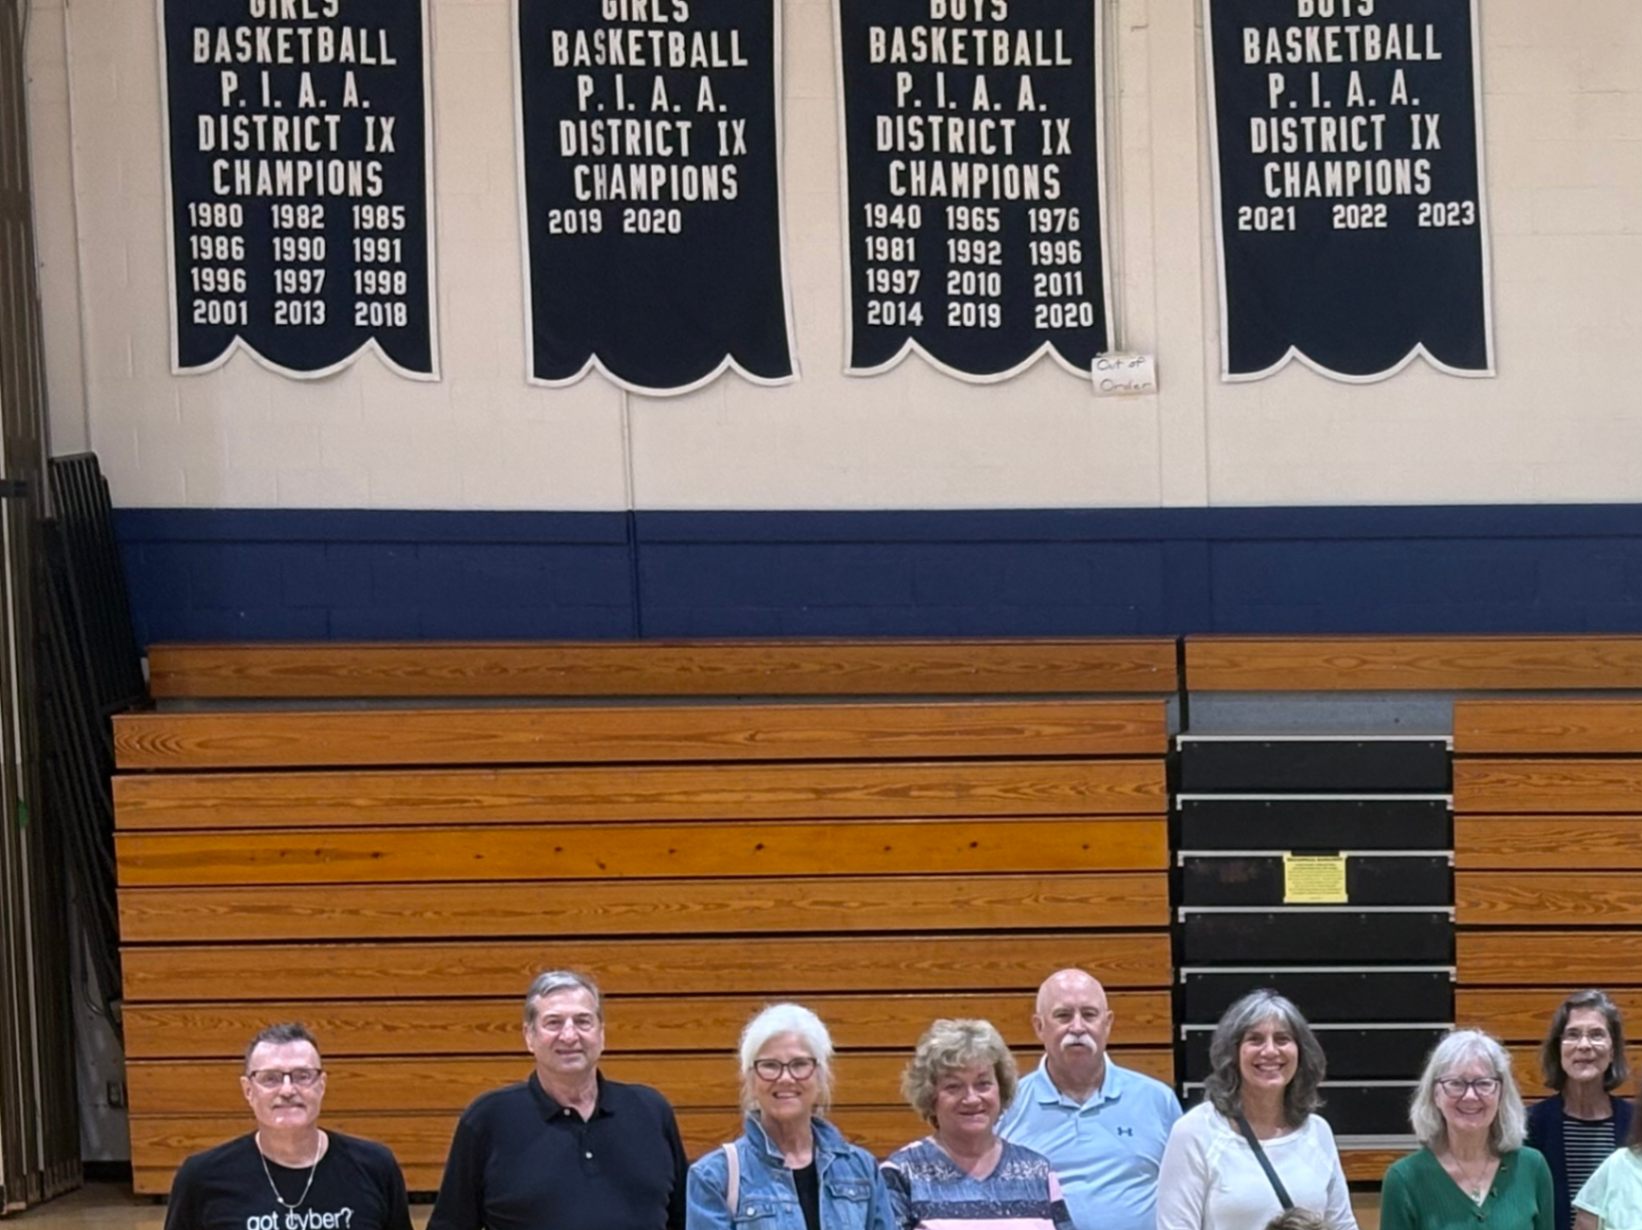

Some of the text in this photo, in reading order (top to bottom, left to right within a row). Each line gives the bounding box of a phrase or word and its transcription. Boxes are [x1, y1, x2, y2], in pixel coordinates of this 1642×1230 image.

[193, 26, 397, 65] BASKETBALL
[551, 28, 748, 68] BASKETBALL
[869, 25, 1072, 66] BASKETBALL
[1243, 23, 1442, 64] BASKETBALL
[198, 114, 395, 153] DISTRICT IX
[559, 118, 747, 157] DISTRICT IX
[876, 115, 1072, 156] DISTRICT IX
[1250, 113, 1441, 154] DISTRICT IX
[213, 158, 383, 197] CHAMPIONS
[574, 163, 738, 201] CHAMPIONS
[889, 159, 1061, 200] CHAMPIONS
[1264, 158, 1431, 198] CHAMPIONS
[188, 202, 405, 230] 1980 1982 1985
[548, 208, 681, 234] 2019 2020
[864, 202, 1080, 233] 1940 1965 1976
[1238, 200, 1475, 231] 2021 2022 2023
[190, 235, 401, 263] 1986 1990 1991
[865, 235, 1082, 266] 1981 1992 1996
[191, 267, 407, 295] 1996 1997 1998
[866, 268, 1083, 298] 1997 2010 2011
[193, 299, 407, 327] 2001 2013 2018
[867, 300, 1094, 329] 2014 2019 2020
[1097, 356, 1146, 371] Out of
[1100, 378, 1152, 392] Order
